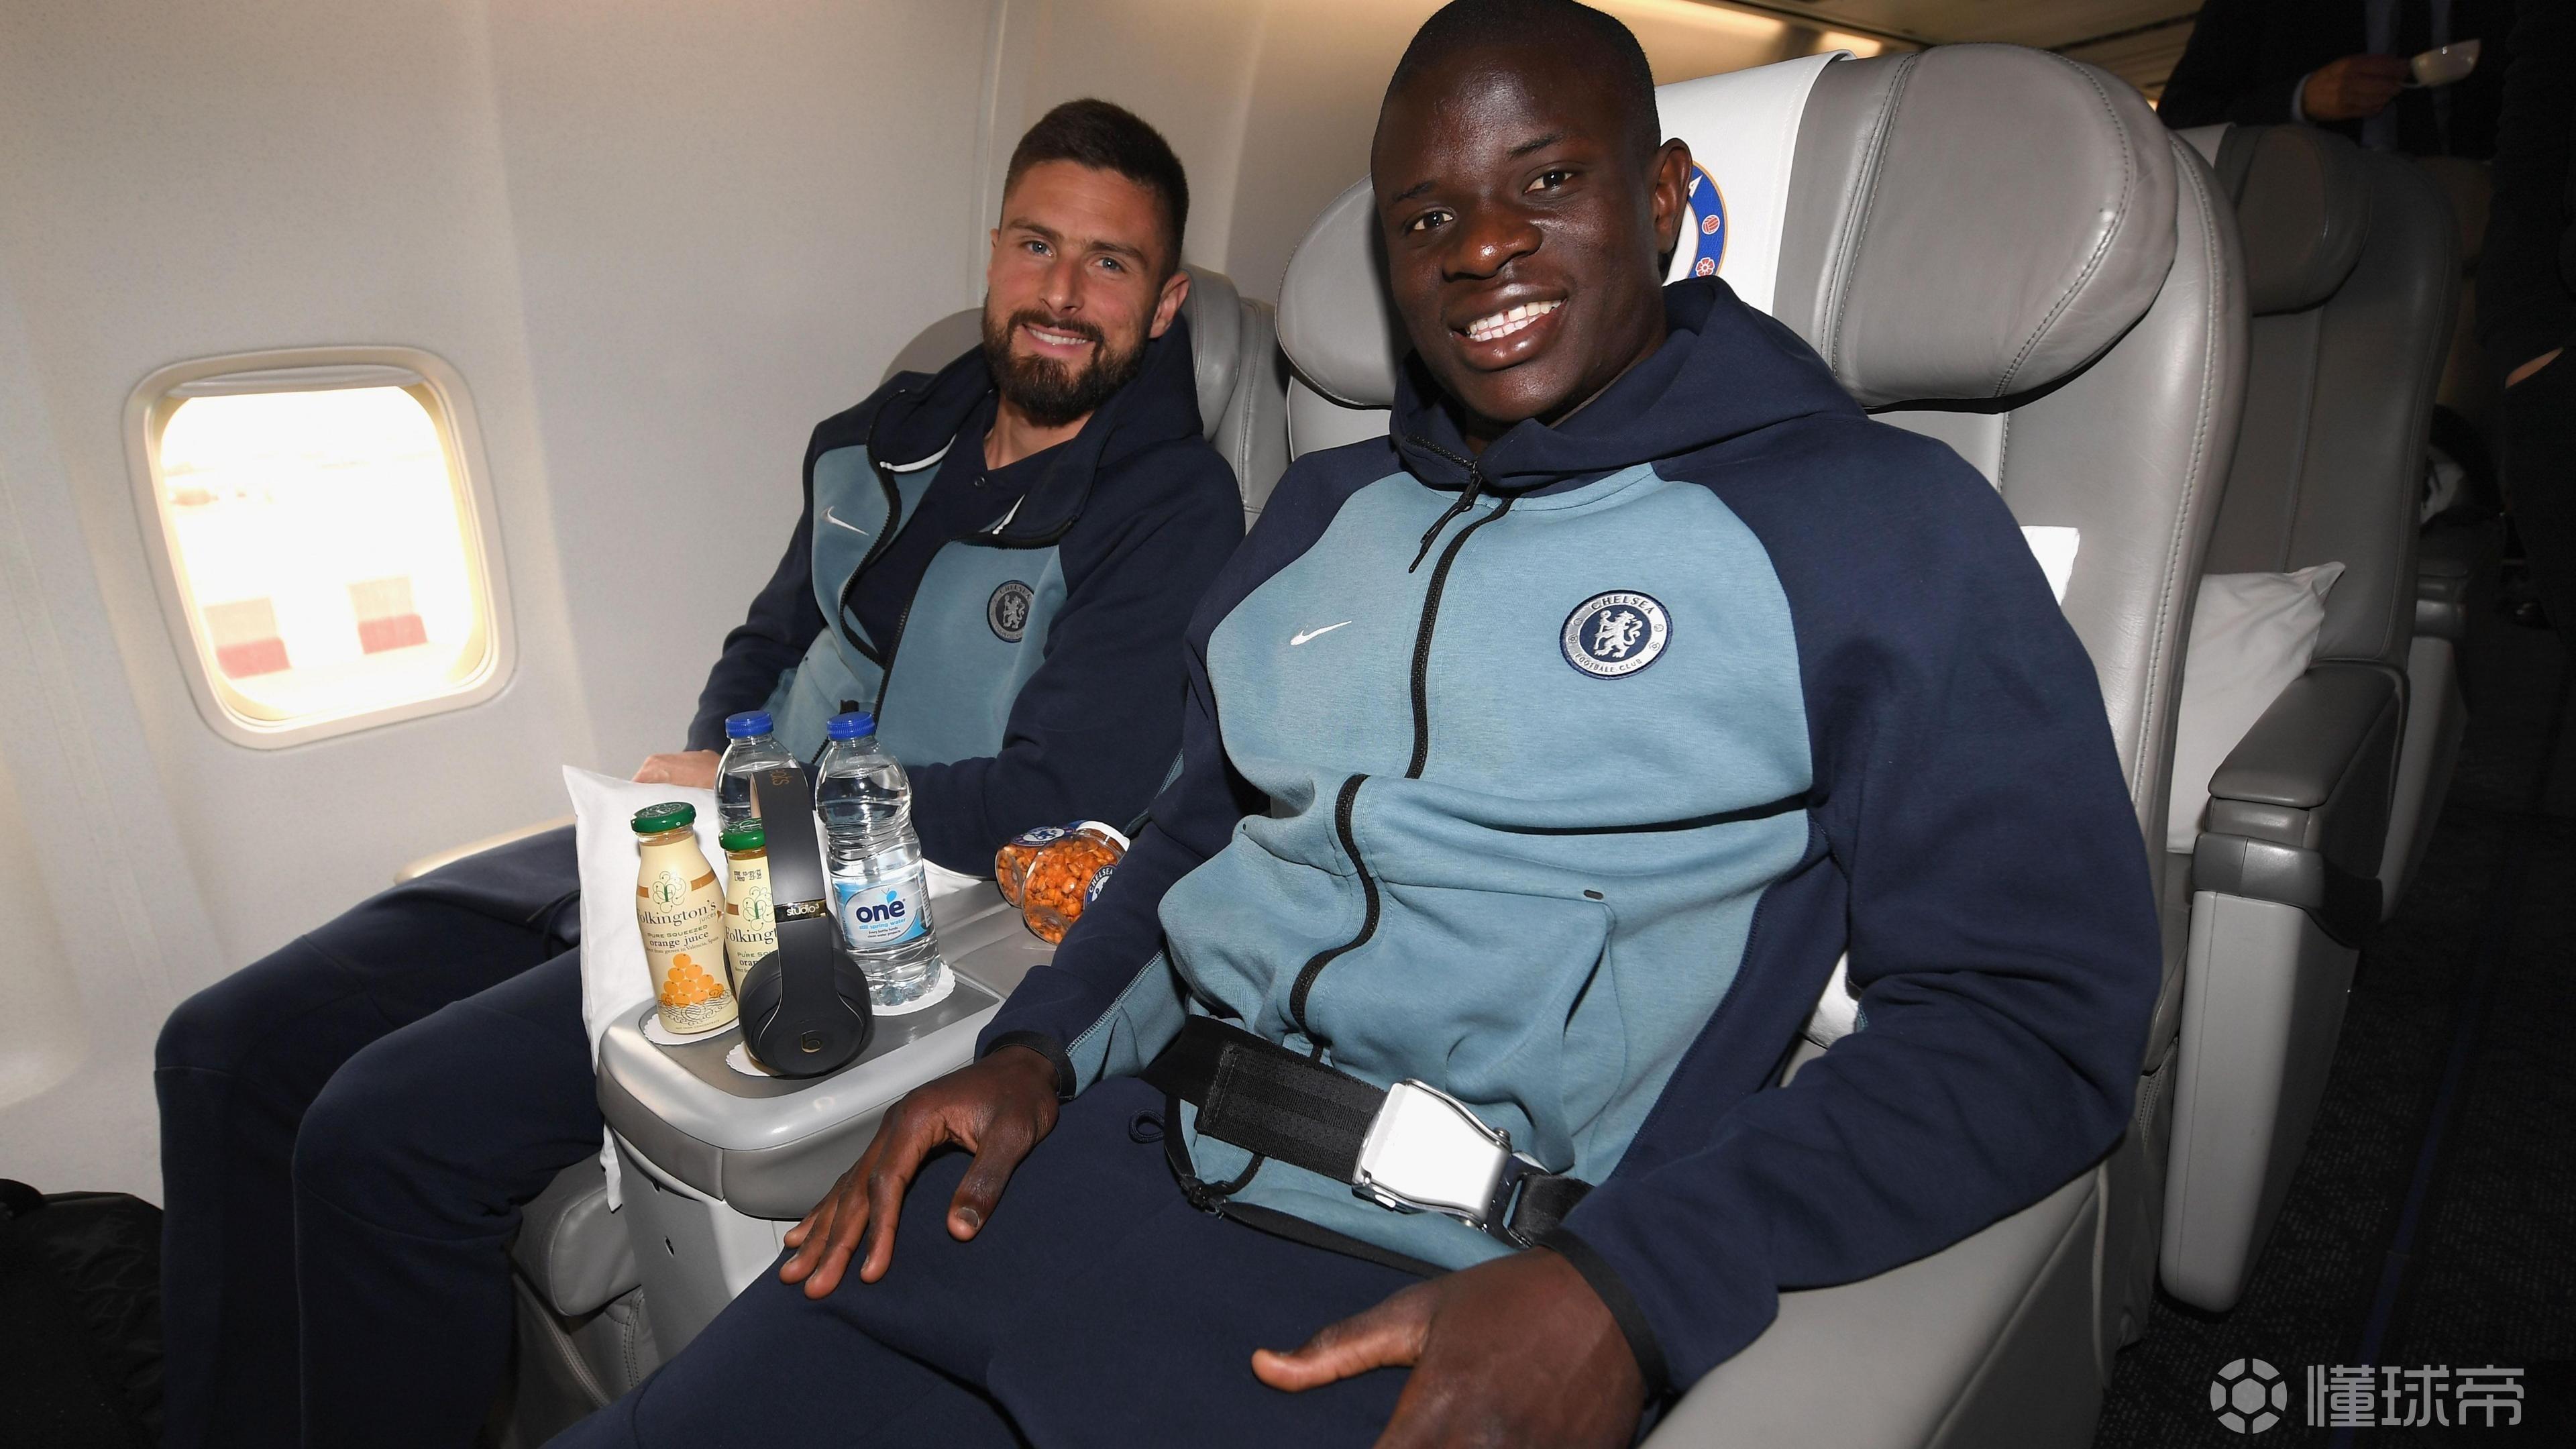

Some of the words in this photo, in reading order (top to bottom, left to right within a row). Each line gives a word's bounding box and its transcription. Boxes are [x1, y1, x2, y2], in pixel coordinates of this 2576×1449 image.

[1591, 595, 1655, 614] CHELSEA
[1575, 652, 1613, 673] FOOTBALL
[1619, 658, 1643, 671] CLUB
[1089, 867, 1113, 894] CHELSEA
[699, 911, 716, 924] juices
[856, 900, 906, 924] one
[667, 924, 708, 938] SQUEEZED
[870, 922, 889, 930] spring
[890, 918, 906, 926] water
[649, 939, 680, 949] orange
[684, 931, 709, 947] juice
